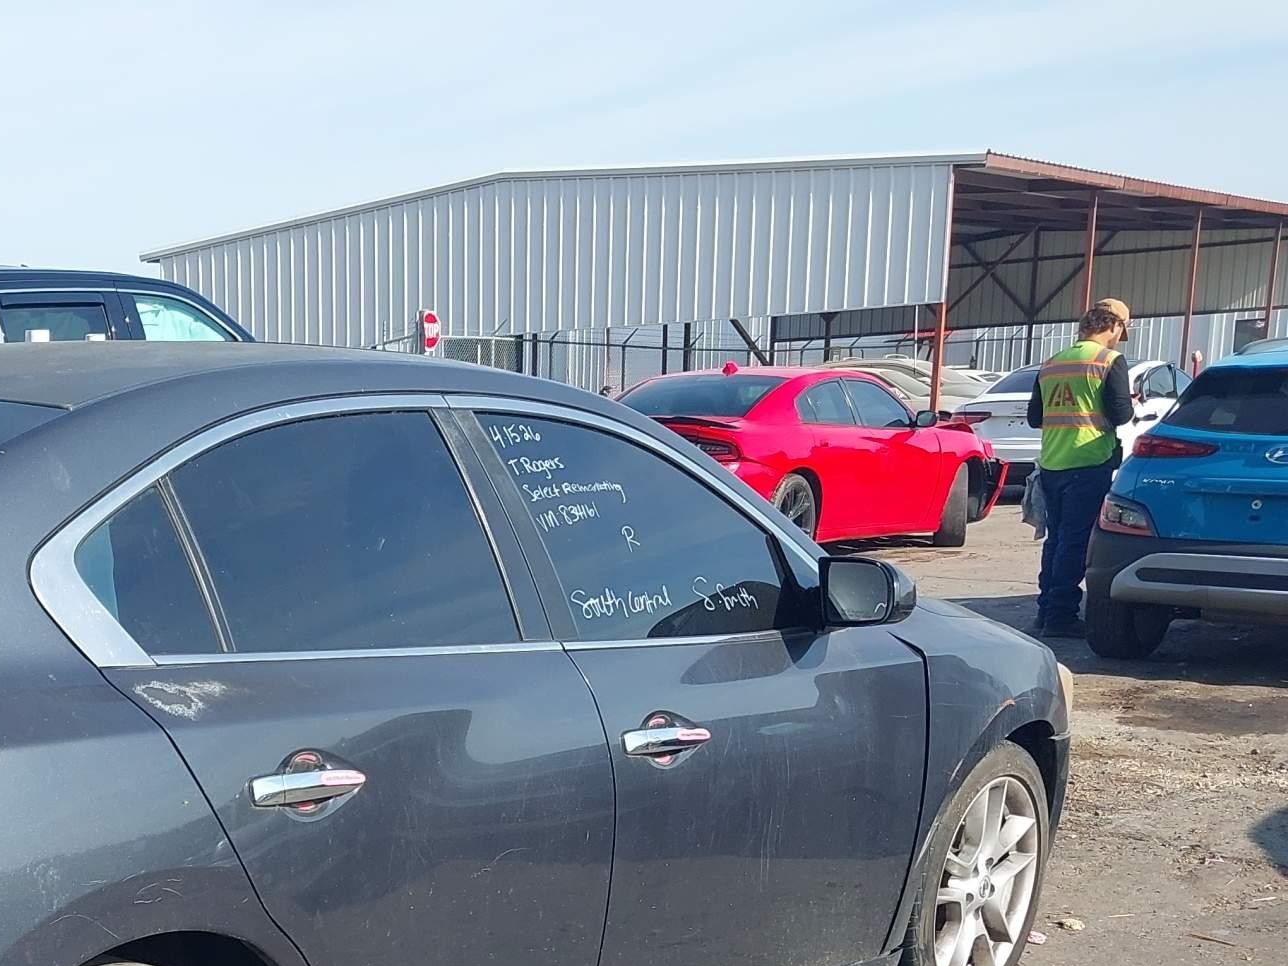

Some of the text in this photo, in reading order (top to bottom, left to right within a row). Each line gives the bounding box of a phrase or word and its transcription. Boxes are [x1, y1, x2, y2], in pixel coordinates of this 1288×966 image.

[423, 322, 440, 338] TOP
[522, 483, 561, 502] Select
[621, 525, 641, 553] R
[570, 586, 630, 619] South
[628, 584, 673, 616] Central
